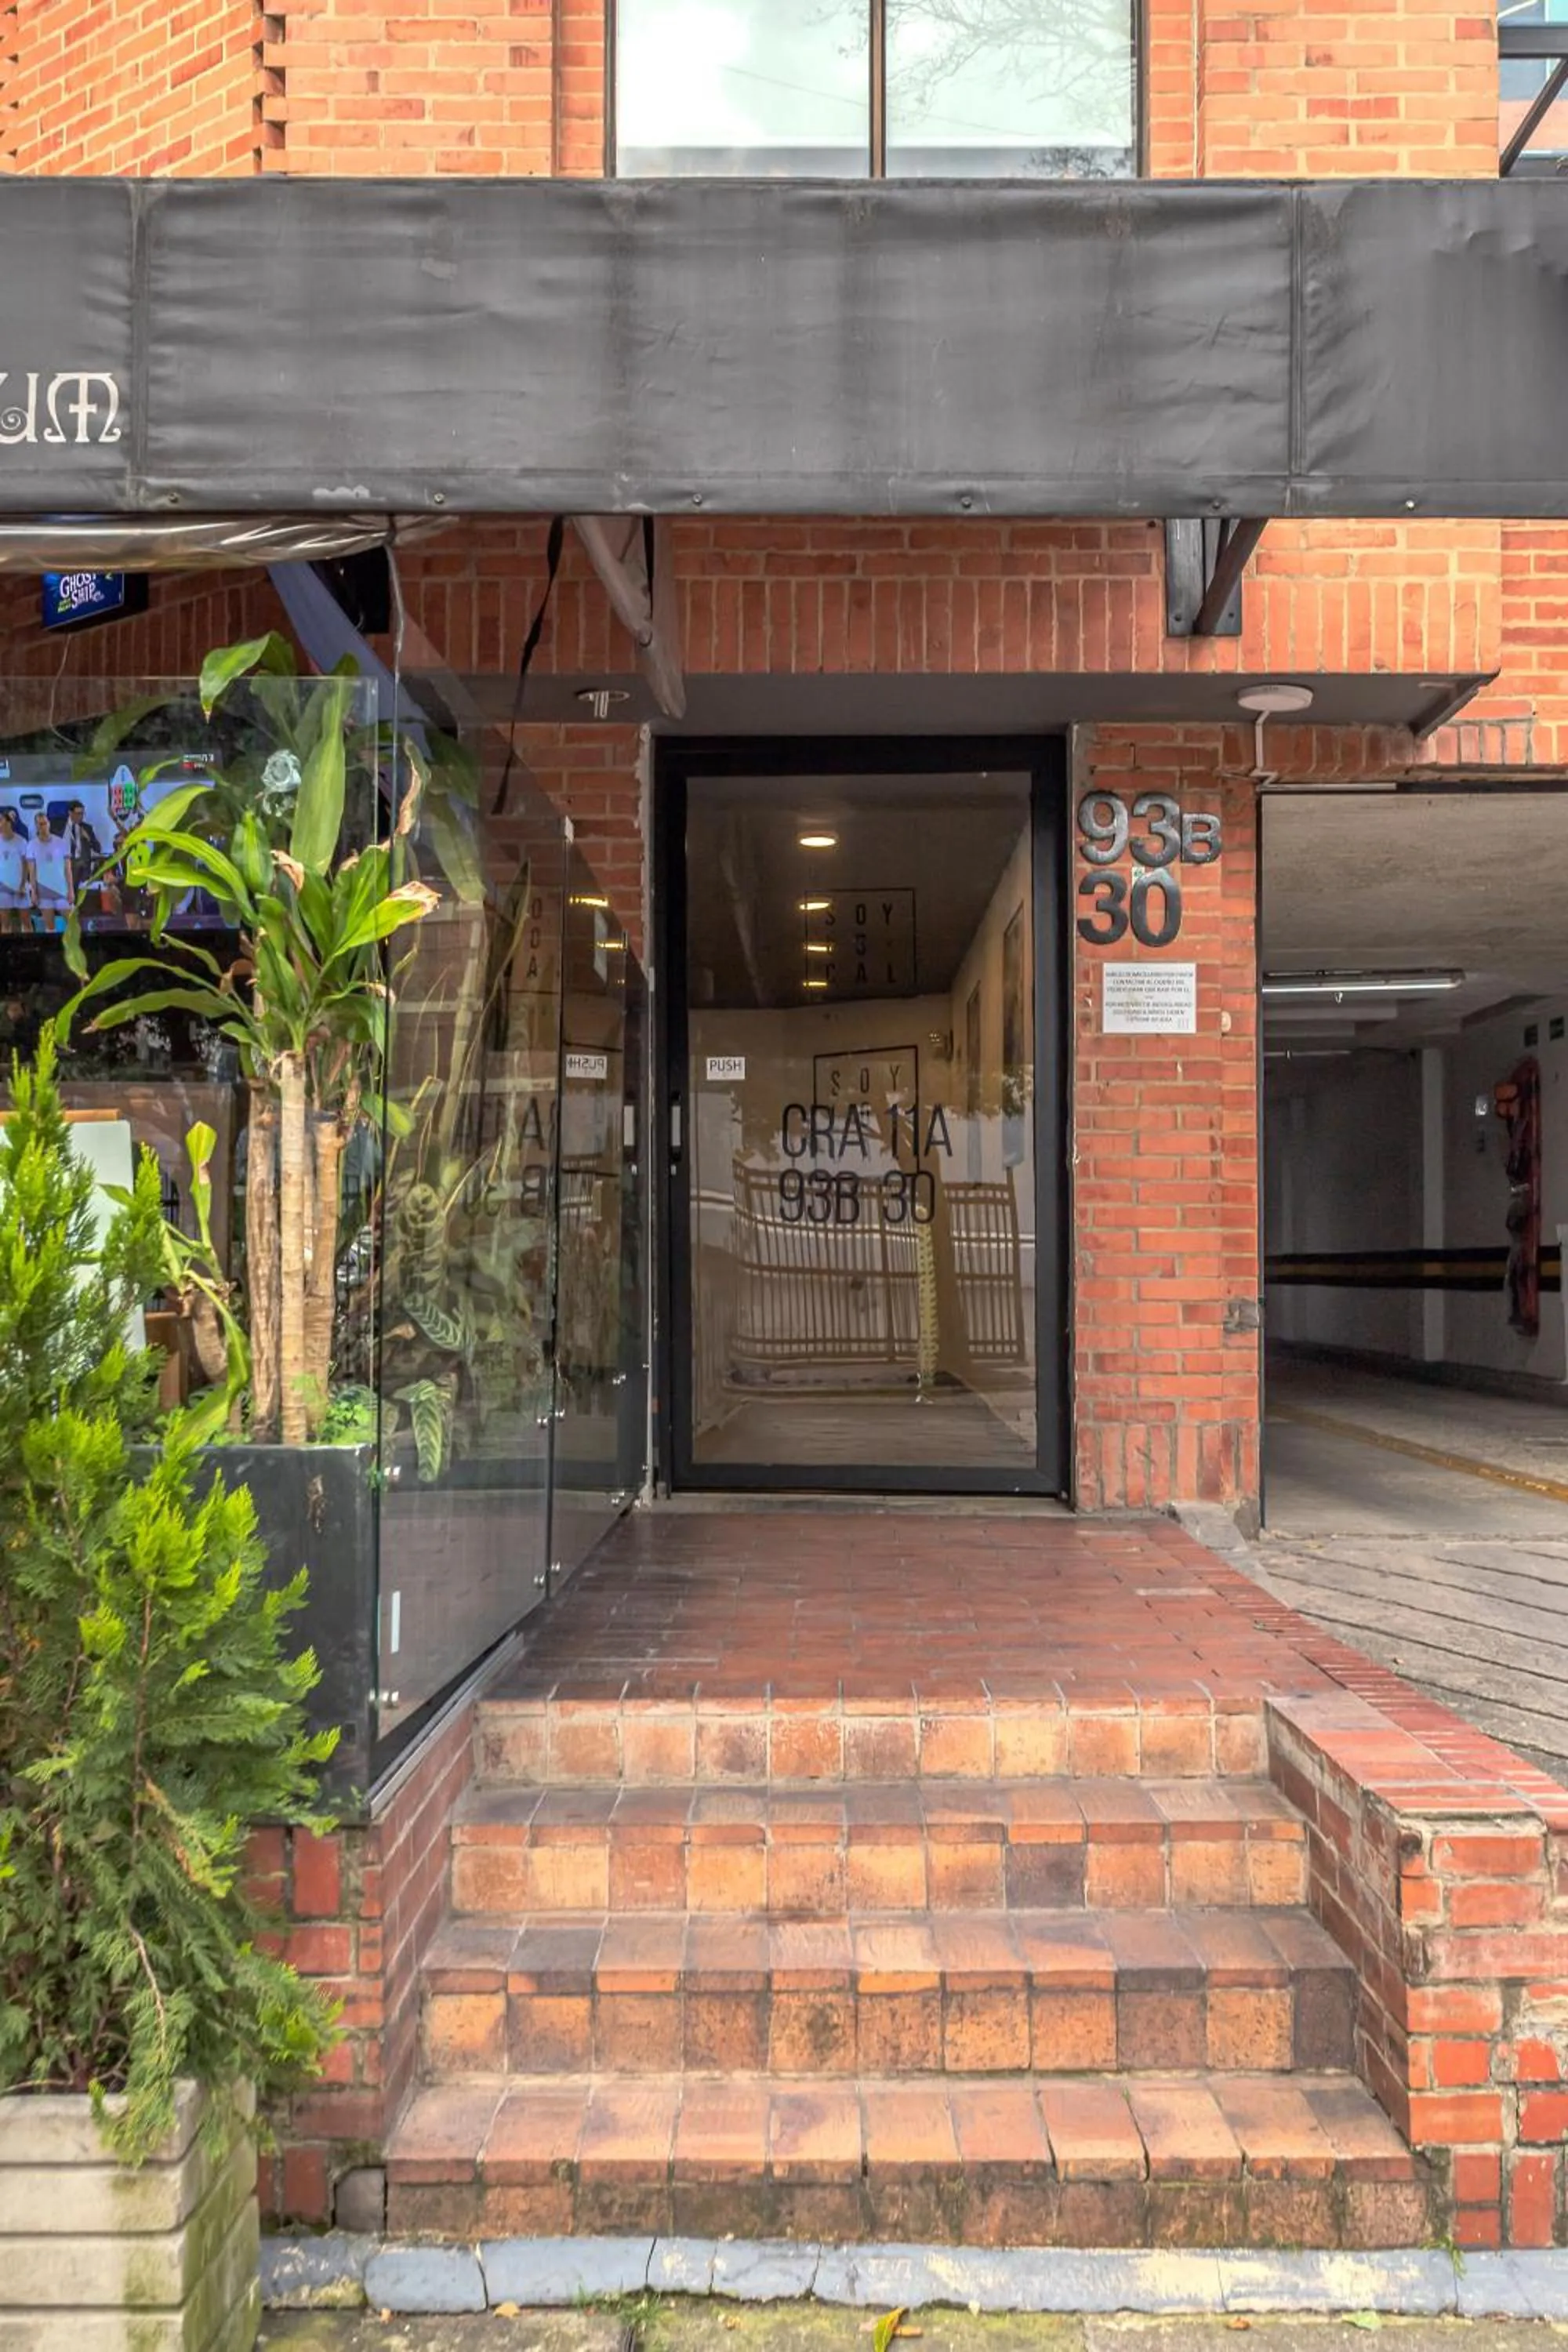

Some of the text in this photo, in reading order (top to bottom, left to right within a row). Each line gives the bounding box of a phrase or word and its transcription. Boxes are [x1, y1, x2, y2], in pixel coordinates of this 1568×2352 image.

[71, 582, 96, 609] SHIP
[1076, 868, 1182, 947] 30
[710, 1059, 742, 1072] PUSH
[830, 1064, 901, 1096] SOY
[782, 1103, 867, 1159] CRA
[889, 1103, 953, 1159] 11A
[779, 1169, 935, 1225] 93B 30
